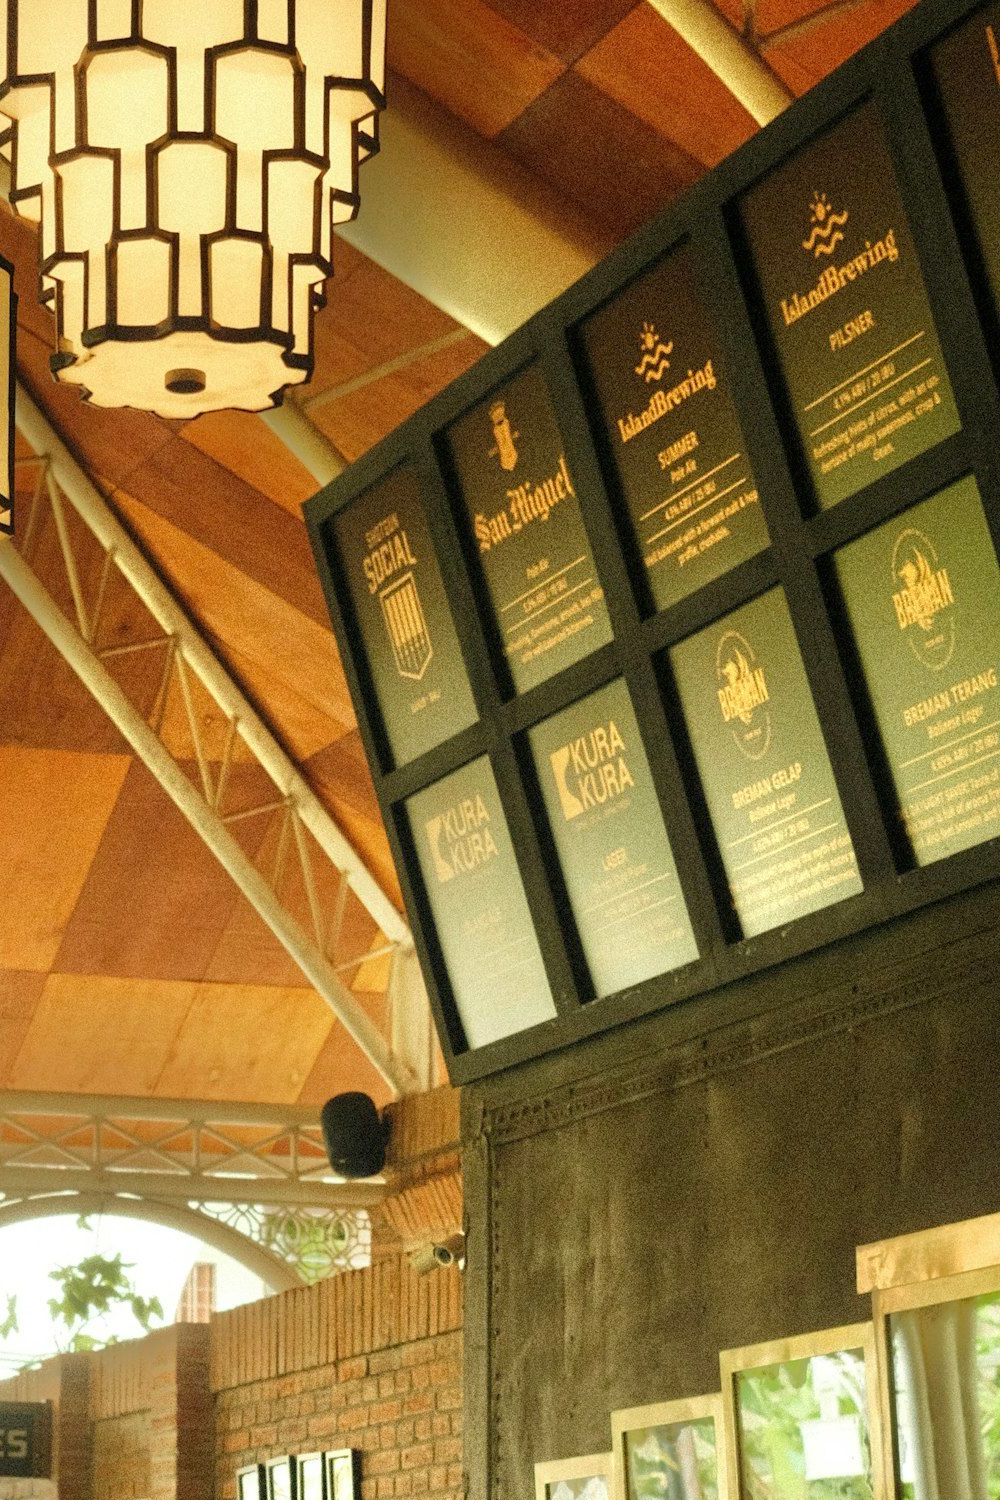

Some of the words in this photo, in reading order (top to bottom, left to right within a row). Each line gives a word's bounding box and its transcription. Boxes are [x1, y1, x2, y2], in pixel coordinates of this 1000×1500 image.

[780, 229, 898, 326] IslandBrewing
[829, 309, 875, 351] PILSNER
[617, 360, 716, 443] IslandBrewing
[657, 431, 700, 470] SUMMER
[474, 512, 512, 552] San
[506, 454, 576, 531] Miguel
[363, 529, 418, 594] SOCIAL
[903, 691, 951, 727] BREMAN
[950, 668, 998, 706] TERANG
[569, 720, 626, 774] KURA
[578, 756, 634, 811] KURA
[732, 776, 773, 810] BREMAN
[772, 762, 803, 792] GELAP
[441, 793, 491, 842] KURA
[449, 826, 500, 874] KURA
